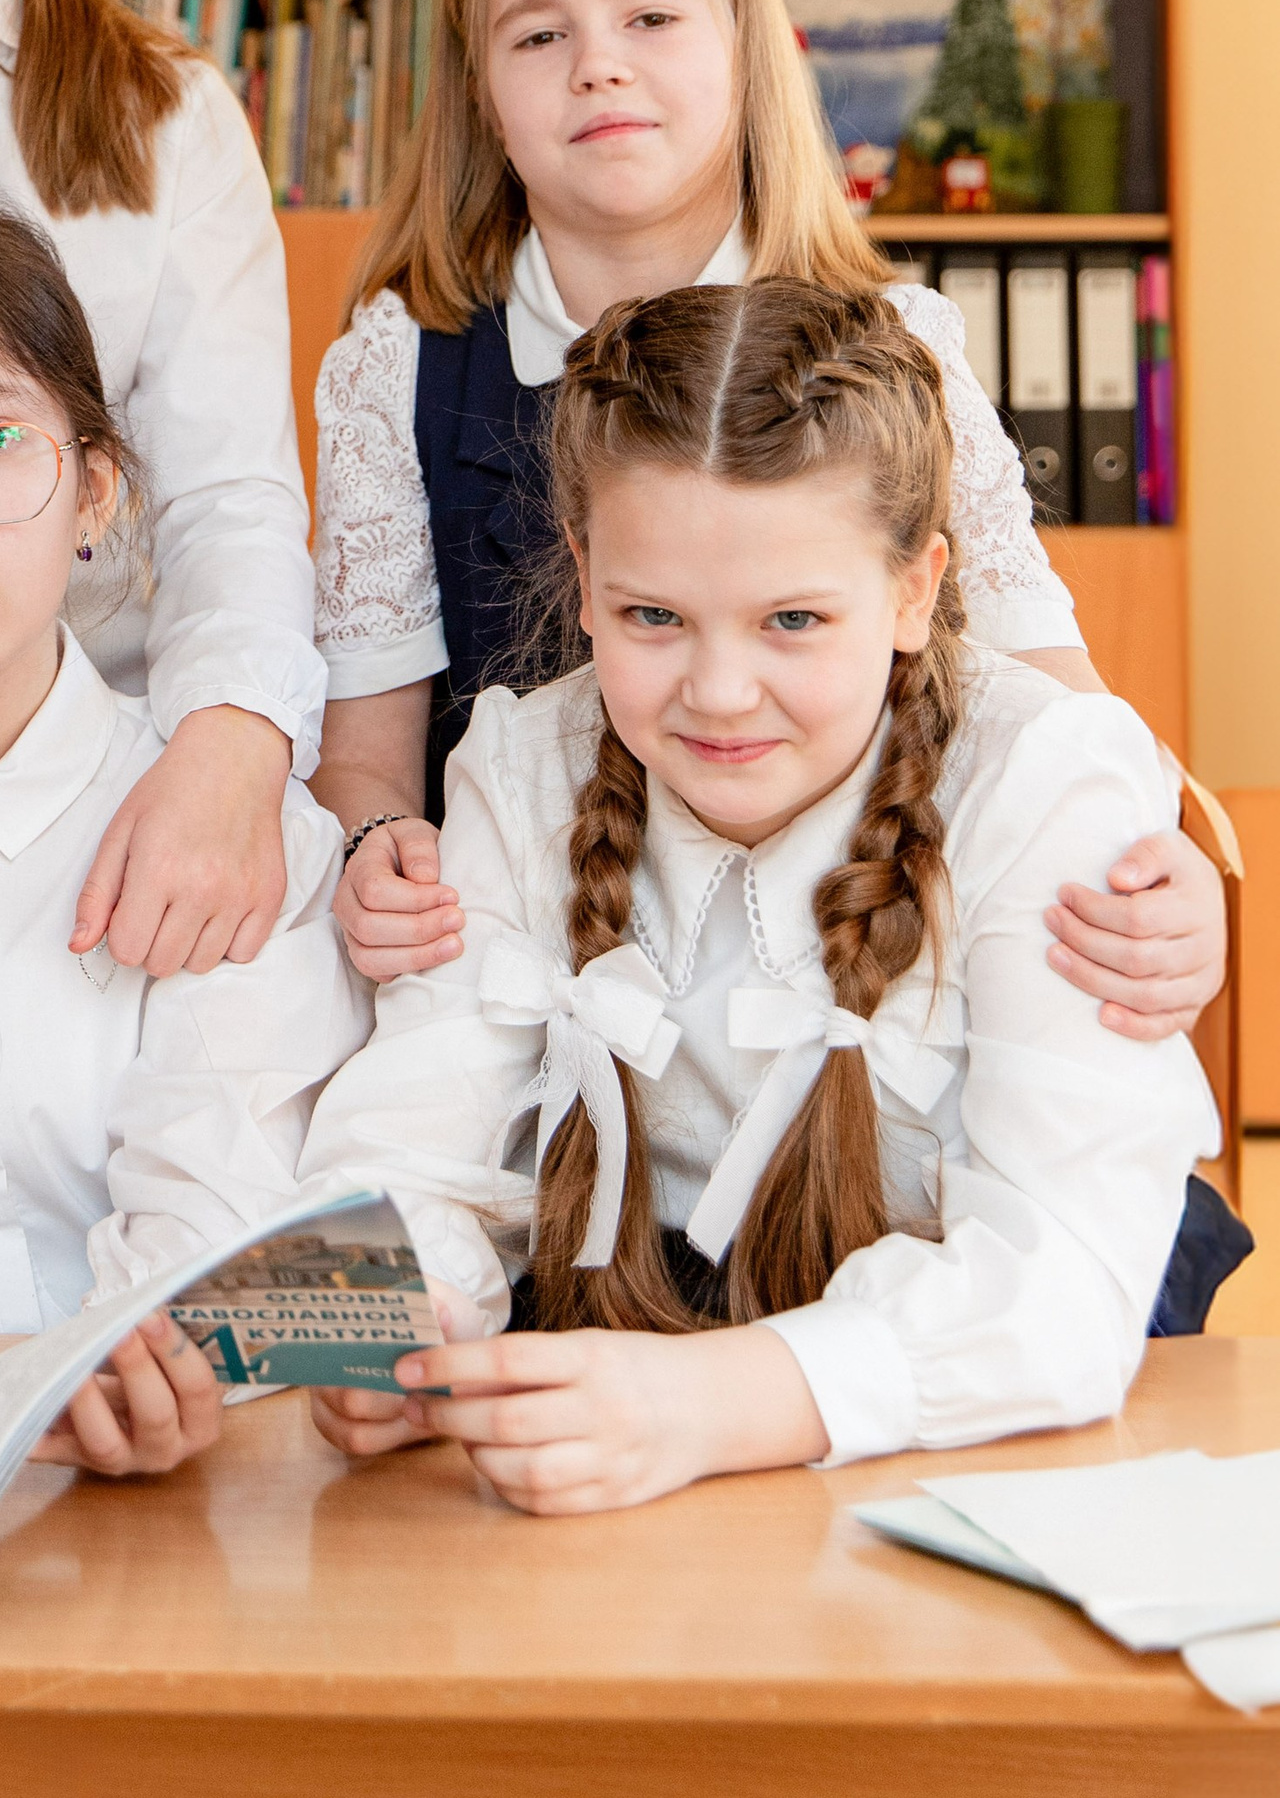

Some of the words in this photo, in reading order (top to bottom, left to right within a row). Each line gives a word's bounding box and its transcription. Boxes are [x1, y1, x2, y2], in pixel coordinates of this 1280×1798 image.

[264, 1292, 405, 1304] ОСНОВЫ
[169, 1308, 410, 1321] РАВОСЛАВНОЙ
[247, 1328, 415, 1340] КУЛЬТУРЫ
[342, 1365, 394, 1378] част
